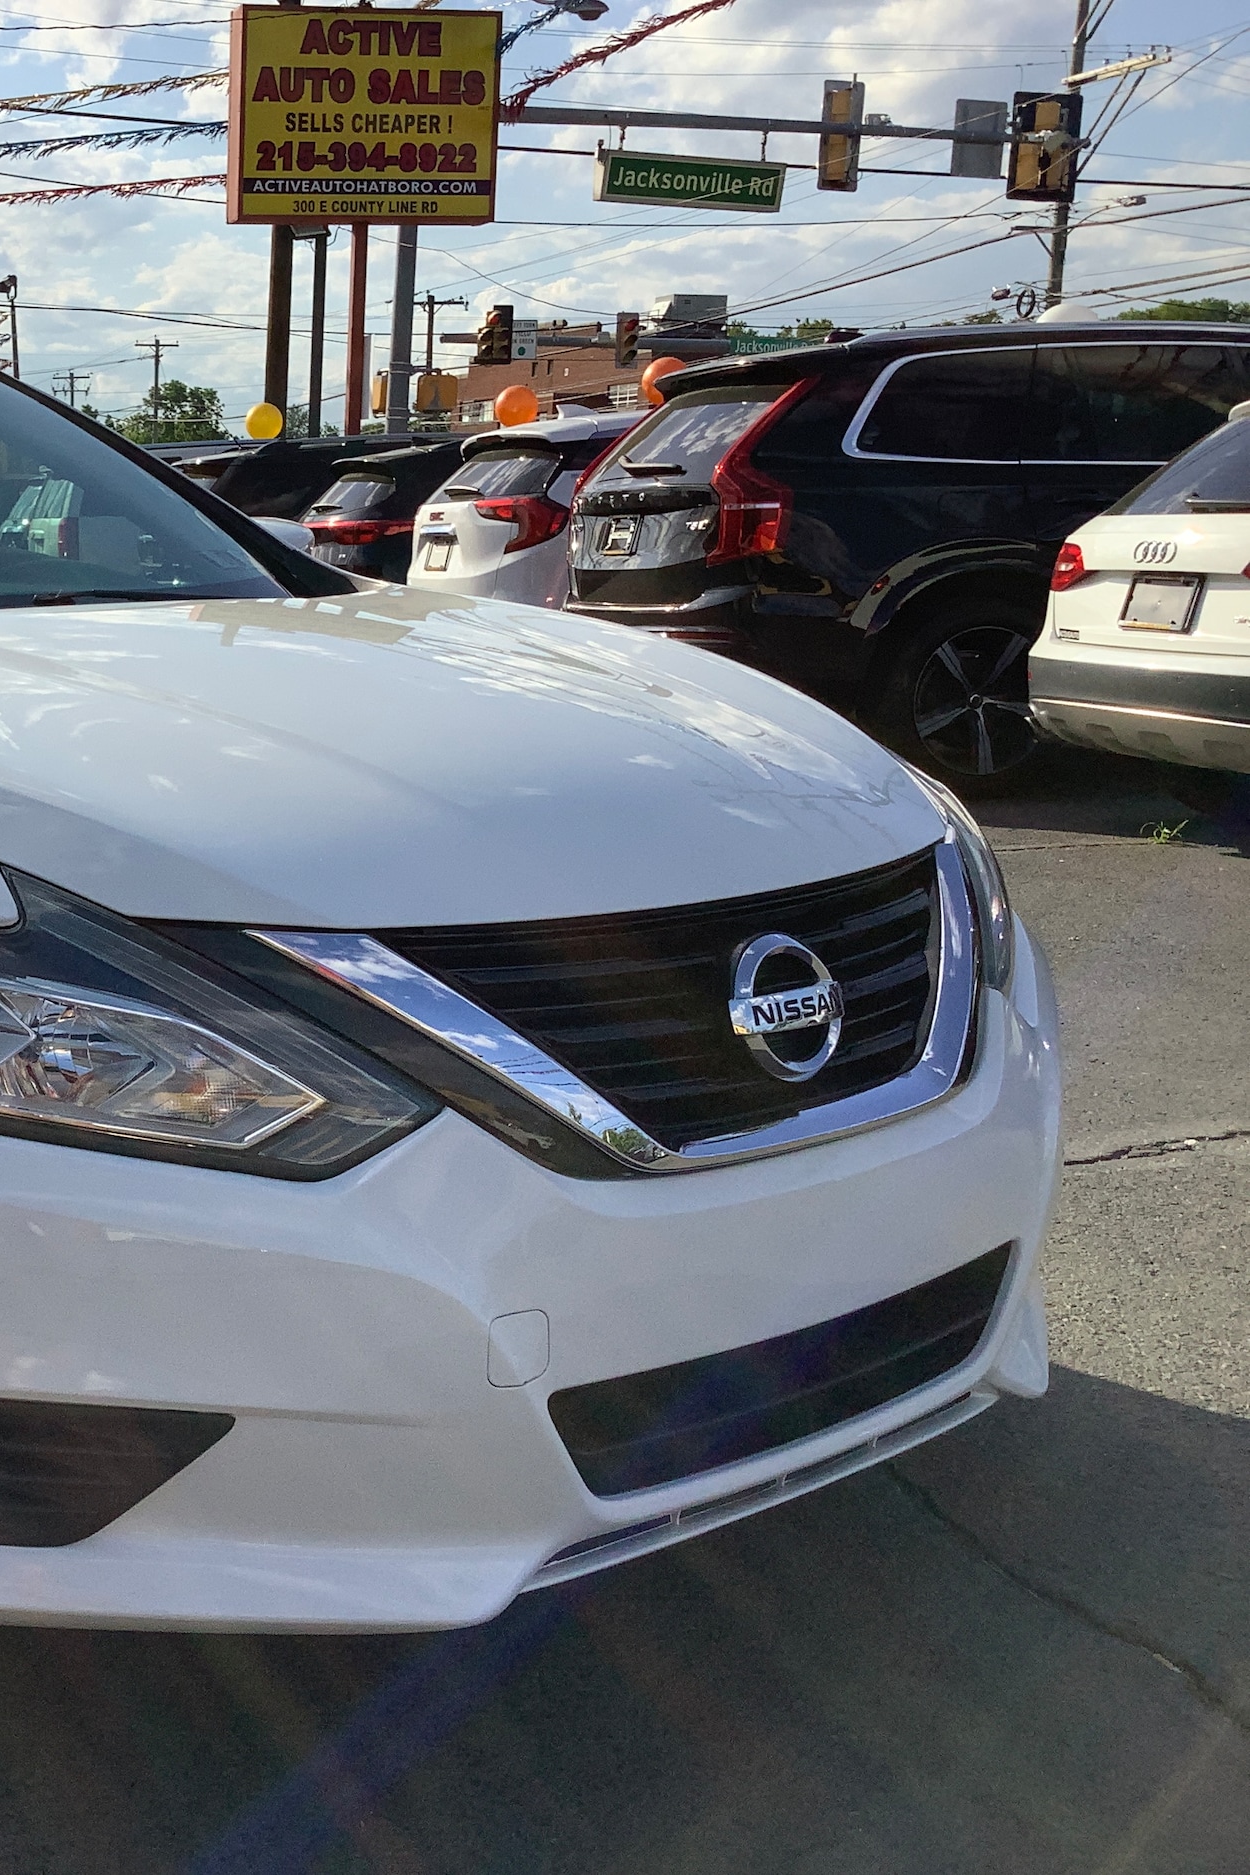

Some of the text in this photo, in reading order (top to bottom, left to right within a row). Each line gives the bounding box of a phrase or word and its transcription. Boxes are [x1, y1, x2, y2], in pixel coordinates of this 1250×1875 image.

[300, 19, 442, 57] ACTIVE
[252, 66, 486, 106] AUTO SALES
[285, 112, 344, 133] SELLS
[351, 113, 441, 134] CHEAPER
[256, 140, 477, 173] 215-394-8922
[253, 180, 477, 194] ACTIVEAUTOHATBORO.COM
[613, 166, 775, 197] Jacksonville Rd
[292, 200, 438, 214] 300 E COUNTY LINE RD
[752, 982, 844, 1027] NISSAN
